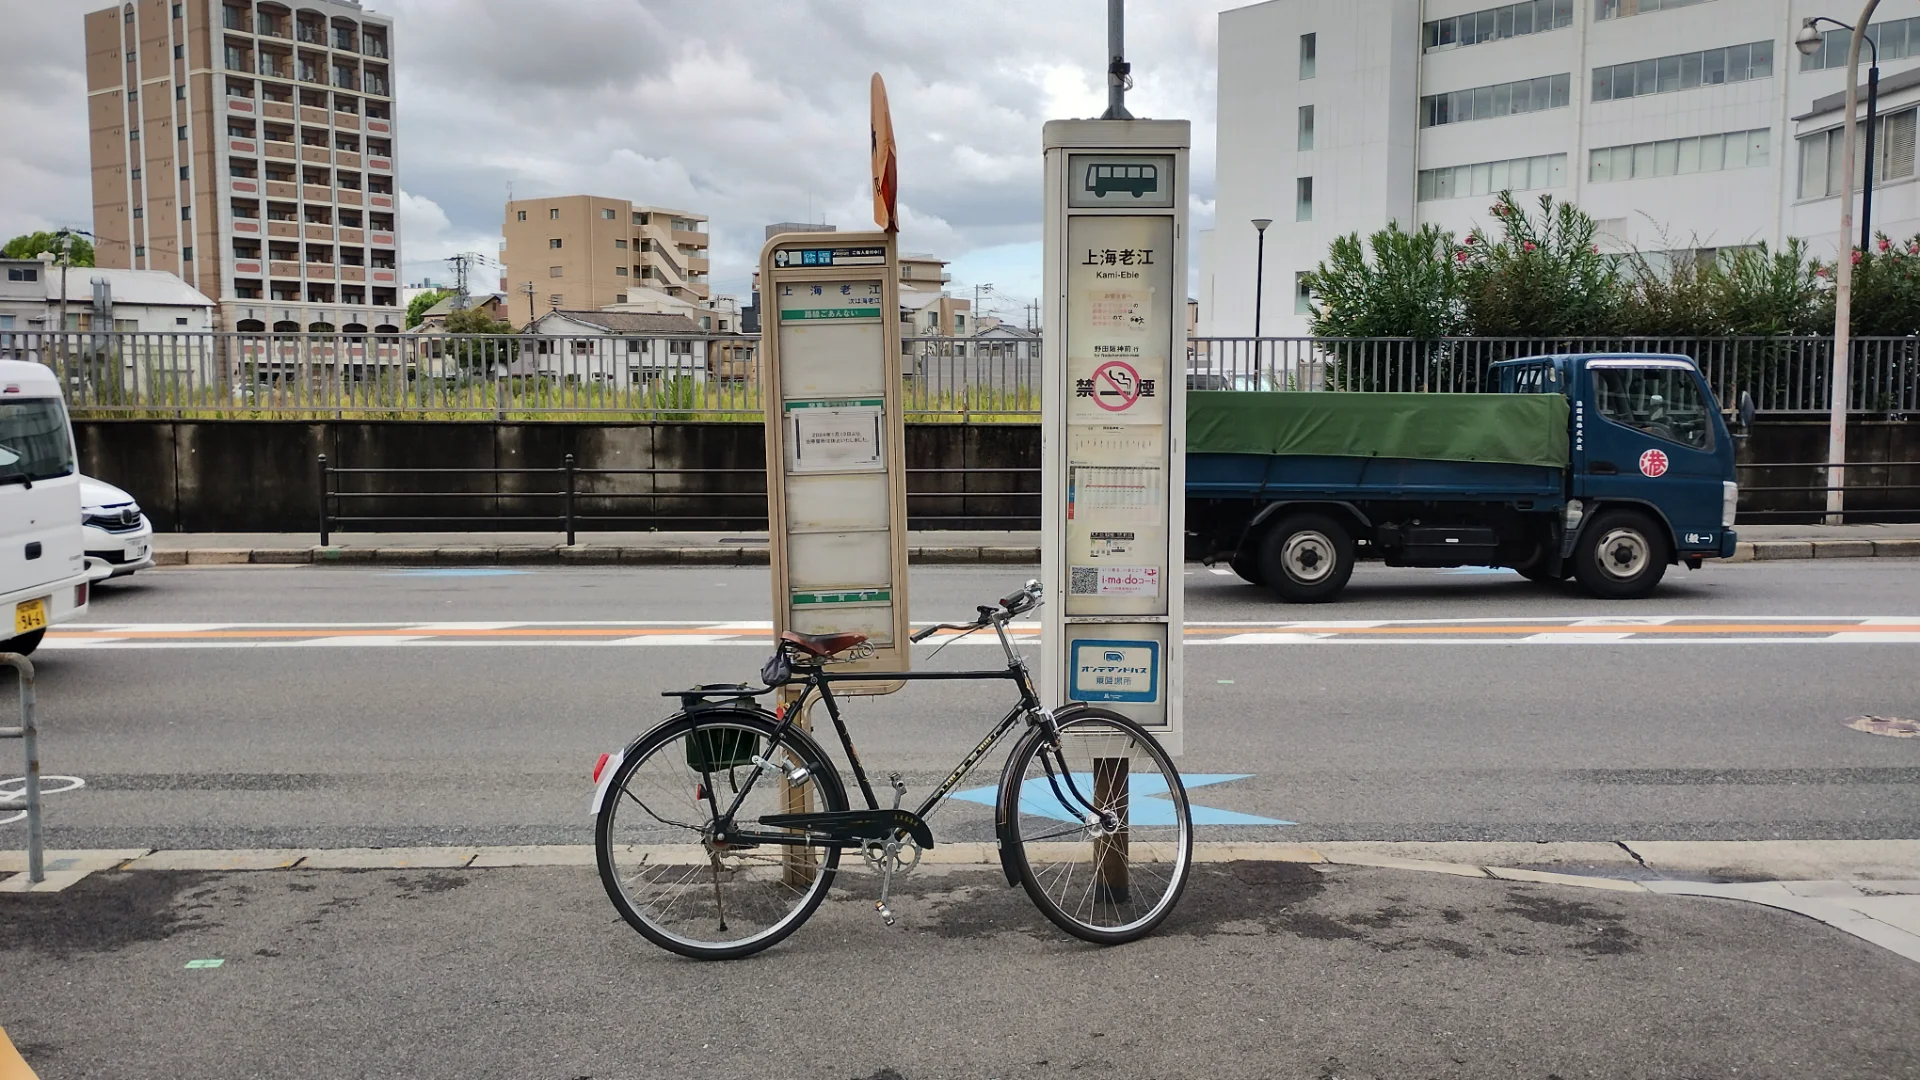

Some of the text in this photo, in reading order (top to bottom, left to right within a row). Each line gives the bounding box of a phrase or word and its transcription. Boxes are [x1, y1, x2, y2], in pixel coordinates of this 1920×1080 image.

[1082, 249, 1154, 266] 上海老江
[1096, 271, 1140, 279] Kami-Ebie
[782, 284, 881, 296] 上海老江
[804, 310, 858, 318] 路線ごあんない
[1076, 379, 1155, 397] 禁 煙
[1640, 450, 1668, 477] 港
